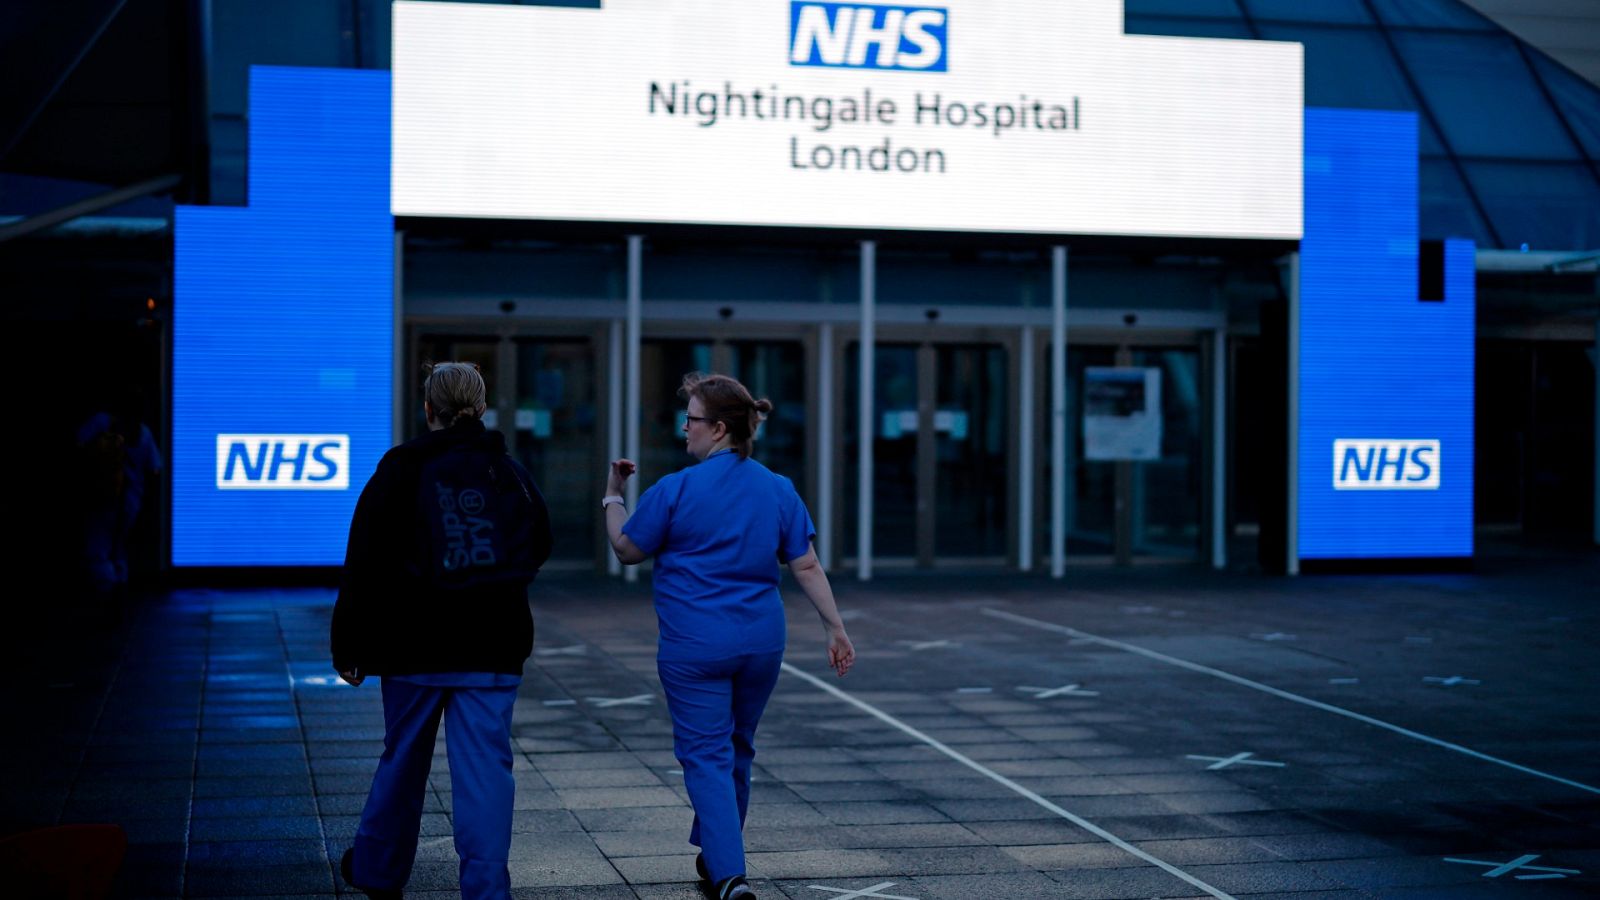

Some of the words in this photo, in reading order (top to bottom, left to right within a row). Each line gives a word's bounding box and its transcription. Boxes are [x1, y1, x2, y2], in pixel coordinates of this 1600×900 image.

[791, 6, 946, 69] NHS
[647, 81, 896, 131] Nightingale
[914, 92, 1081, 135] Hospital
[790, 136, 946, 173] London
[223, 441, 341, 482] NHS
[1340, 446, 1434, 482] NHS
[435, 481, 470, 570] Super
